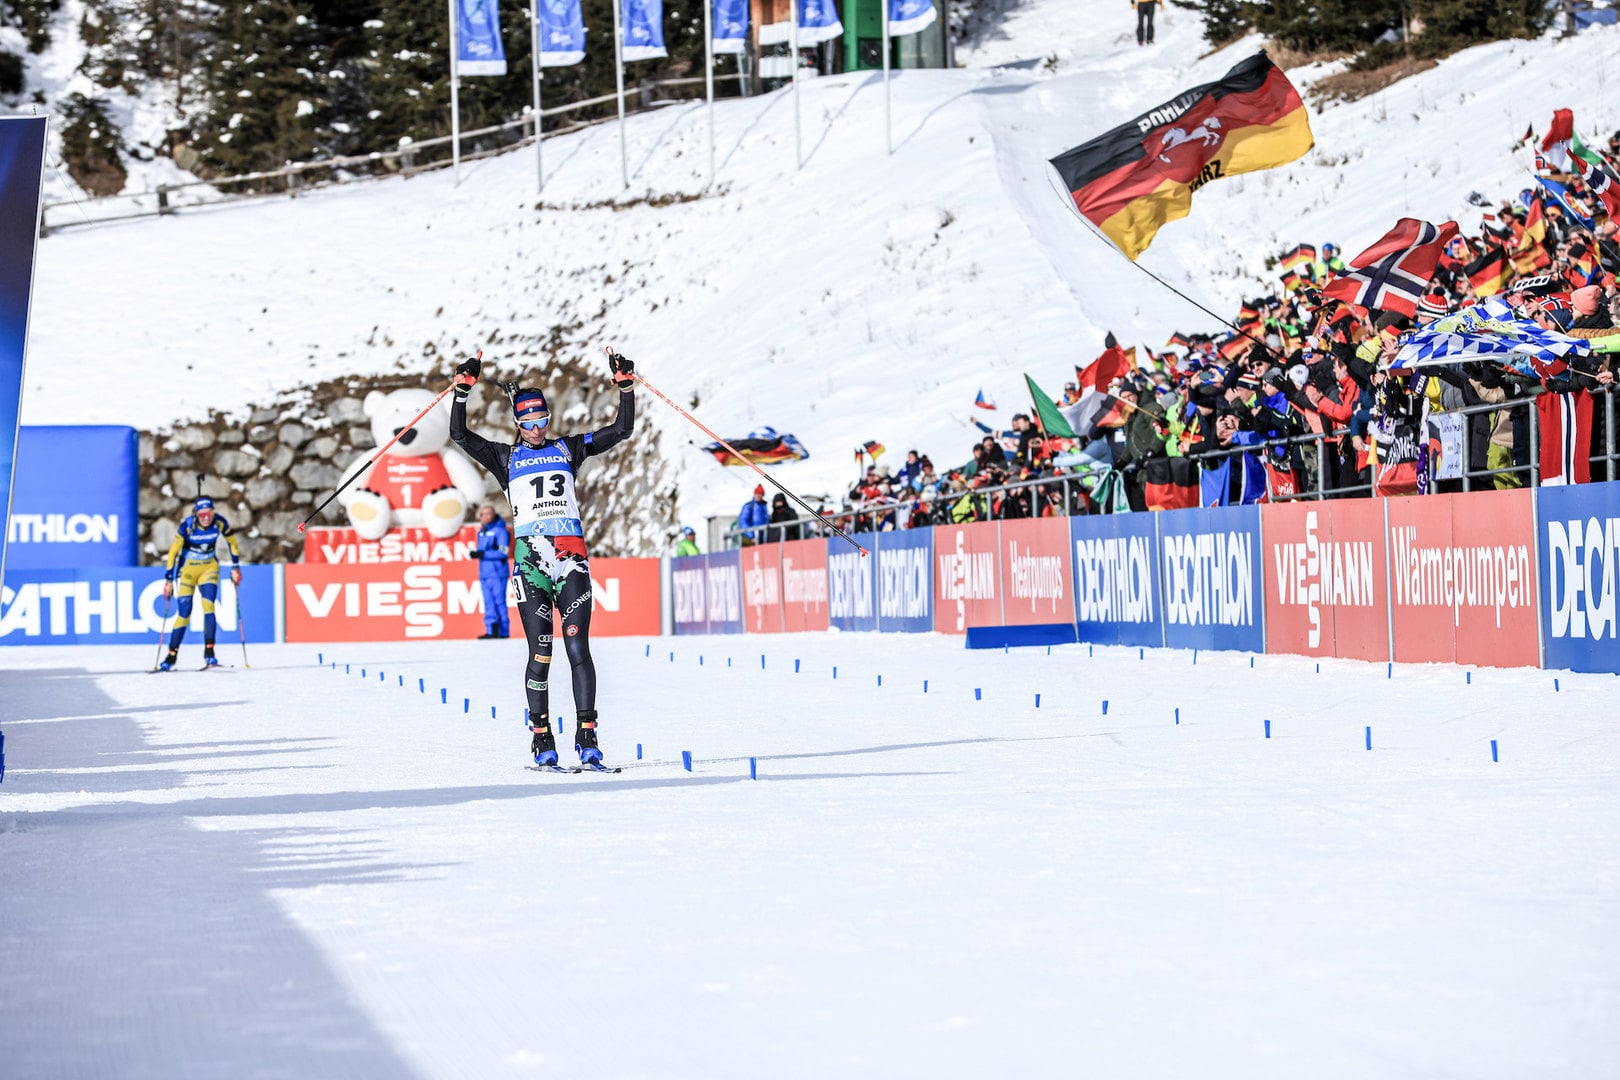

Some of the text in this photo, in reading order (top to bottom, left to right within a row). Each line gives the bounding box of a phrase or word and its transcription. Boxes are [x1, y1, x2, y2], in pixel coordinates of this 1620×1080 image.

[515, 455, 568, 470] DECATHLON
[401, 484, 411, 507] 1
[529, 473, 566, 499] 13
[513, 505, 519, 518] 3
[532, 500, 568, 510] ANTHOLZ
[554, 519, 575, 534] iX1
[321, 533, 477, 565] VIESMAN
[512, 578, 522, 601] 3
[939, 530, 995, 632] VIESSMANN
[1009, 539, 1064, 614] Heatpumps
[1075, 535, 1154, 624] DECATHLON
[1163, 530, 1253, 628] DECATHLON
[1273, 511, 1375, 649] VIESSMANN
[1391, 525, 1532, 629] Wärmepumpen
[294, 564, 620, 638] VIESSMN
[561, 591, 593, 625] ALCONER
